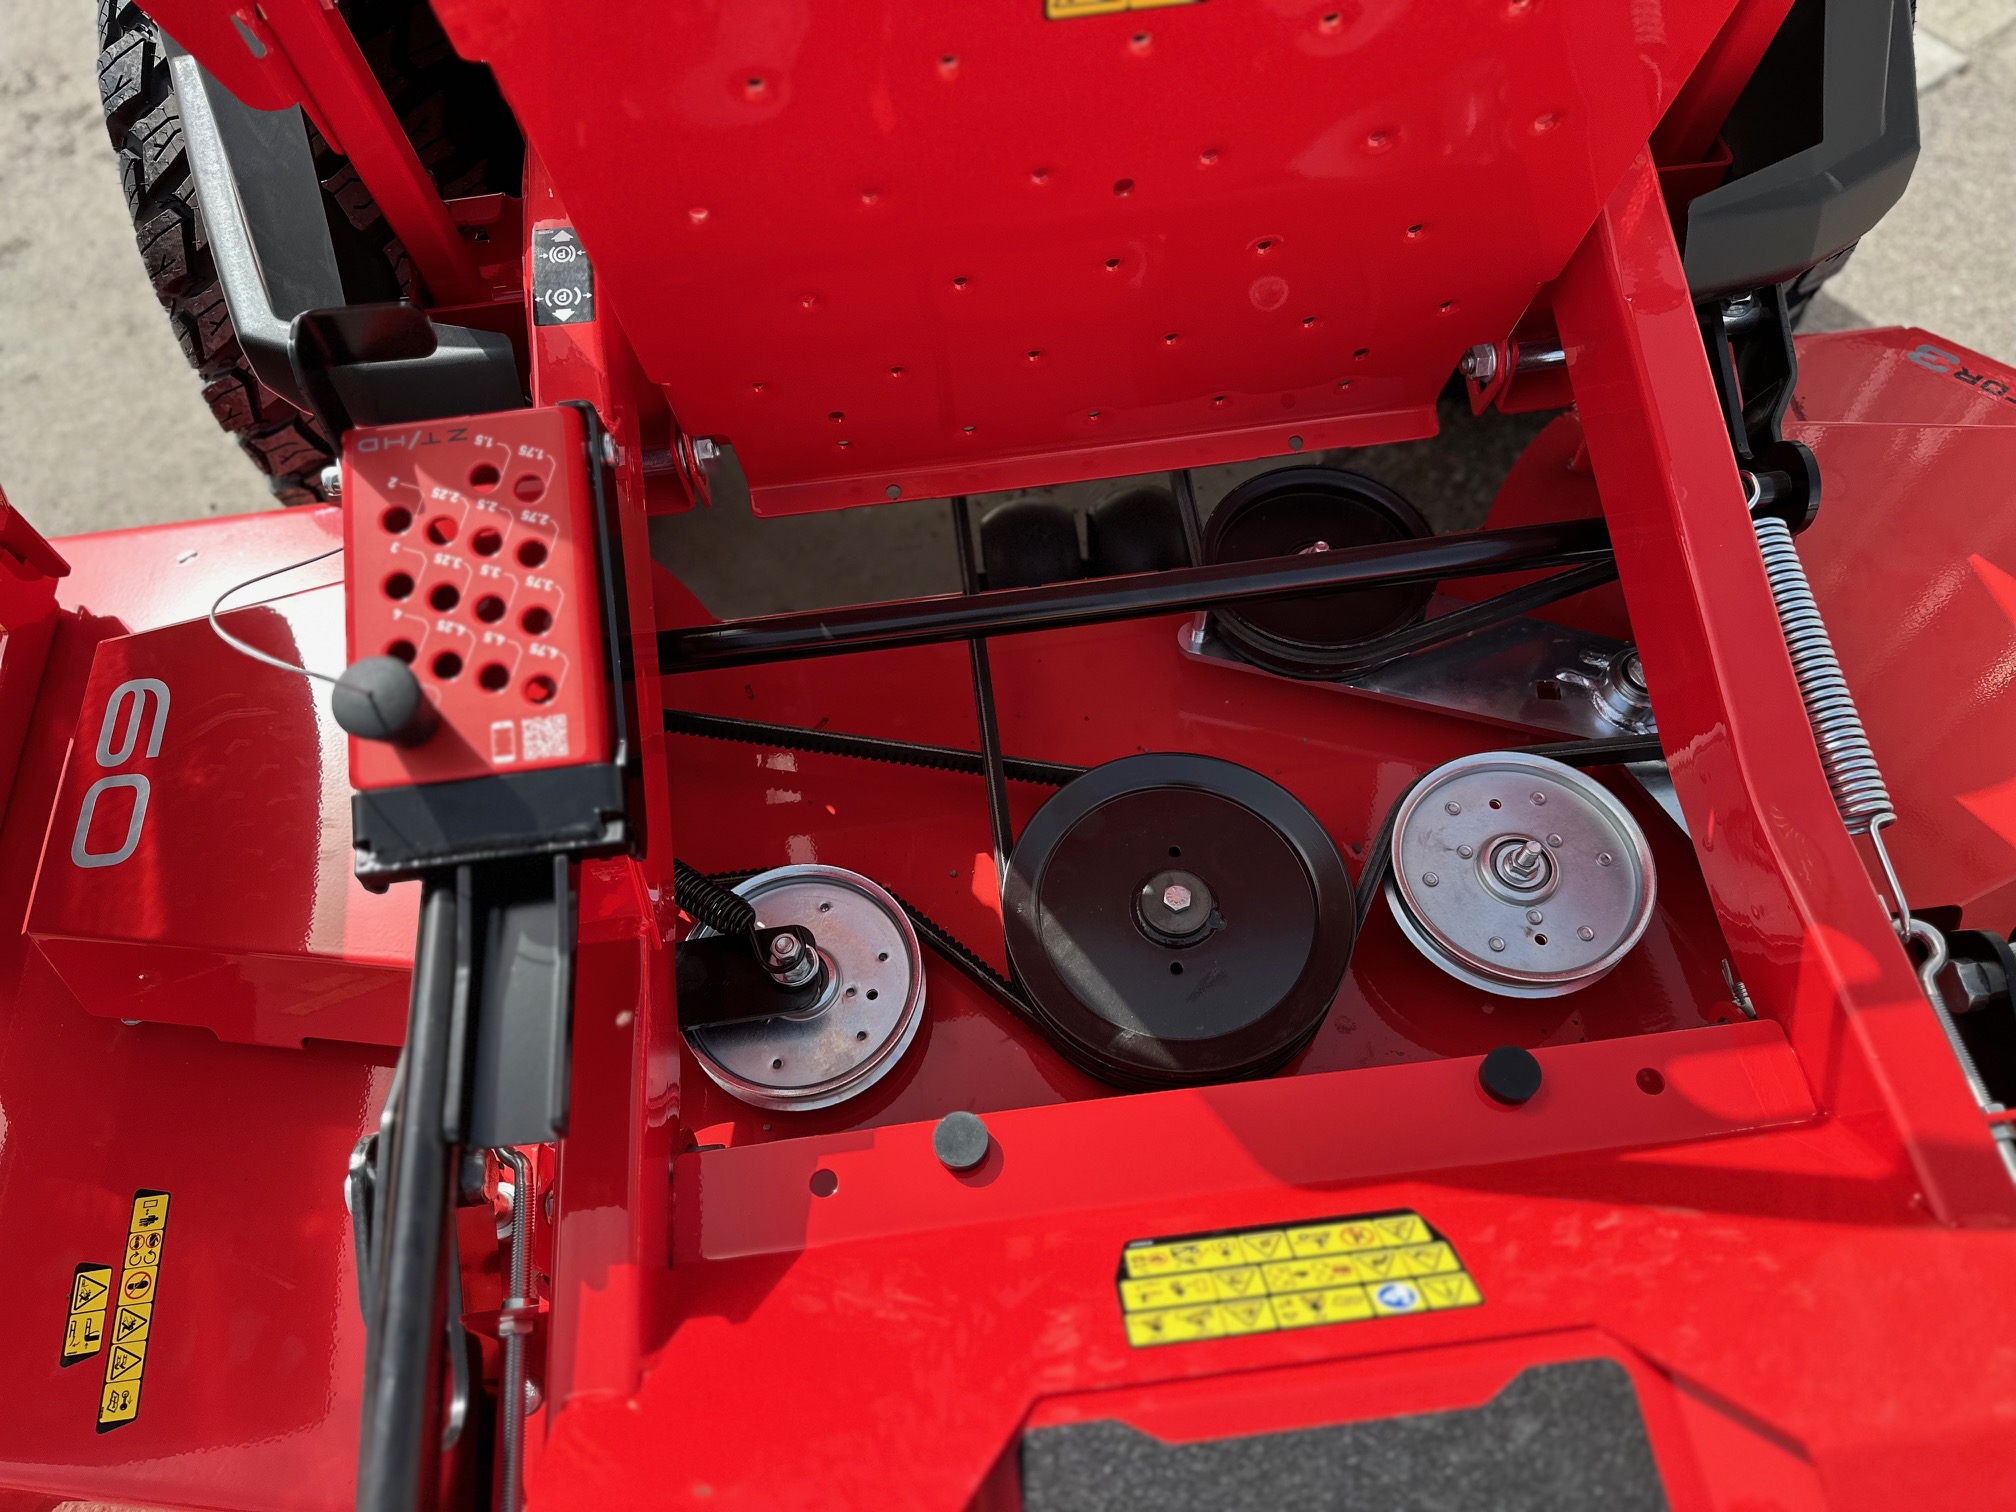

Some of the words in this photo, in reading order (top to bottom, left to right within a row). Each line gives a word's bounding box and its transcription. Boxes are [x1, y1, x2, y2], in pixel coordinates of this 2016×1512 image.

[357, 427, 468, 451] ZT/HD
[474, 434, 493, 448] 1.5
[518, 445, 544, 460] 1.75
[387, 477, 398, 488] 2
[431, 487, 461, 503] 2.25
[476, 499, 498, 513] 2.5
[520, 509, 550, 525] 2.75
[390, 542, 400, 554] 3
[433, 553, 463, 569] 3.25
[479, 564, 501, 578] 3.5
[525, 575, 555, 591] 3.75
[393, 608, 403, 620] 4
[436, 619, 467, 636] 4.25
[482, 631, 506, 645] 4.5
[528, 642, 559, 659] 4.75
[71, 678, 170, 868] 60
